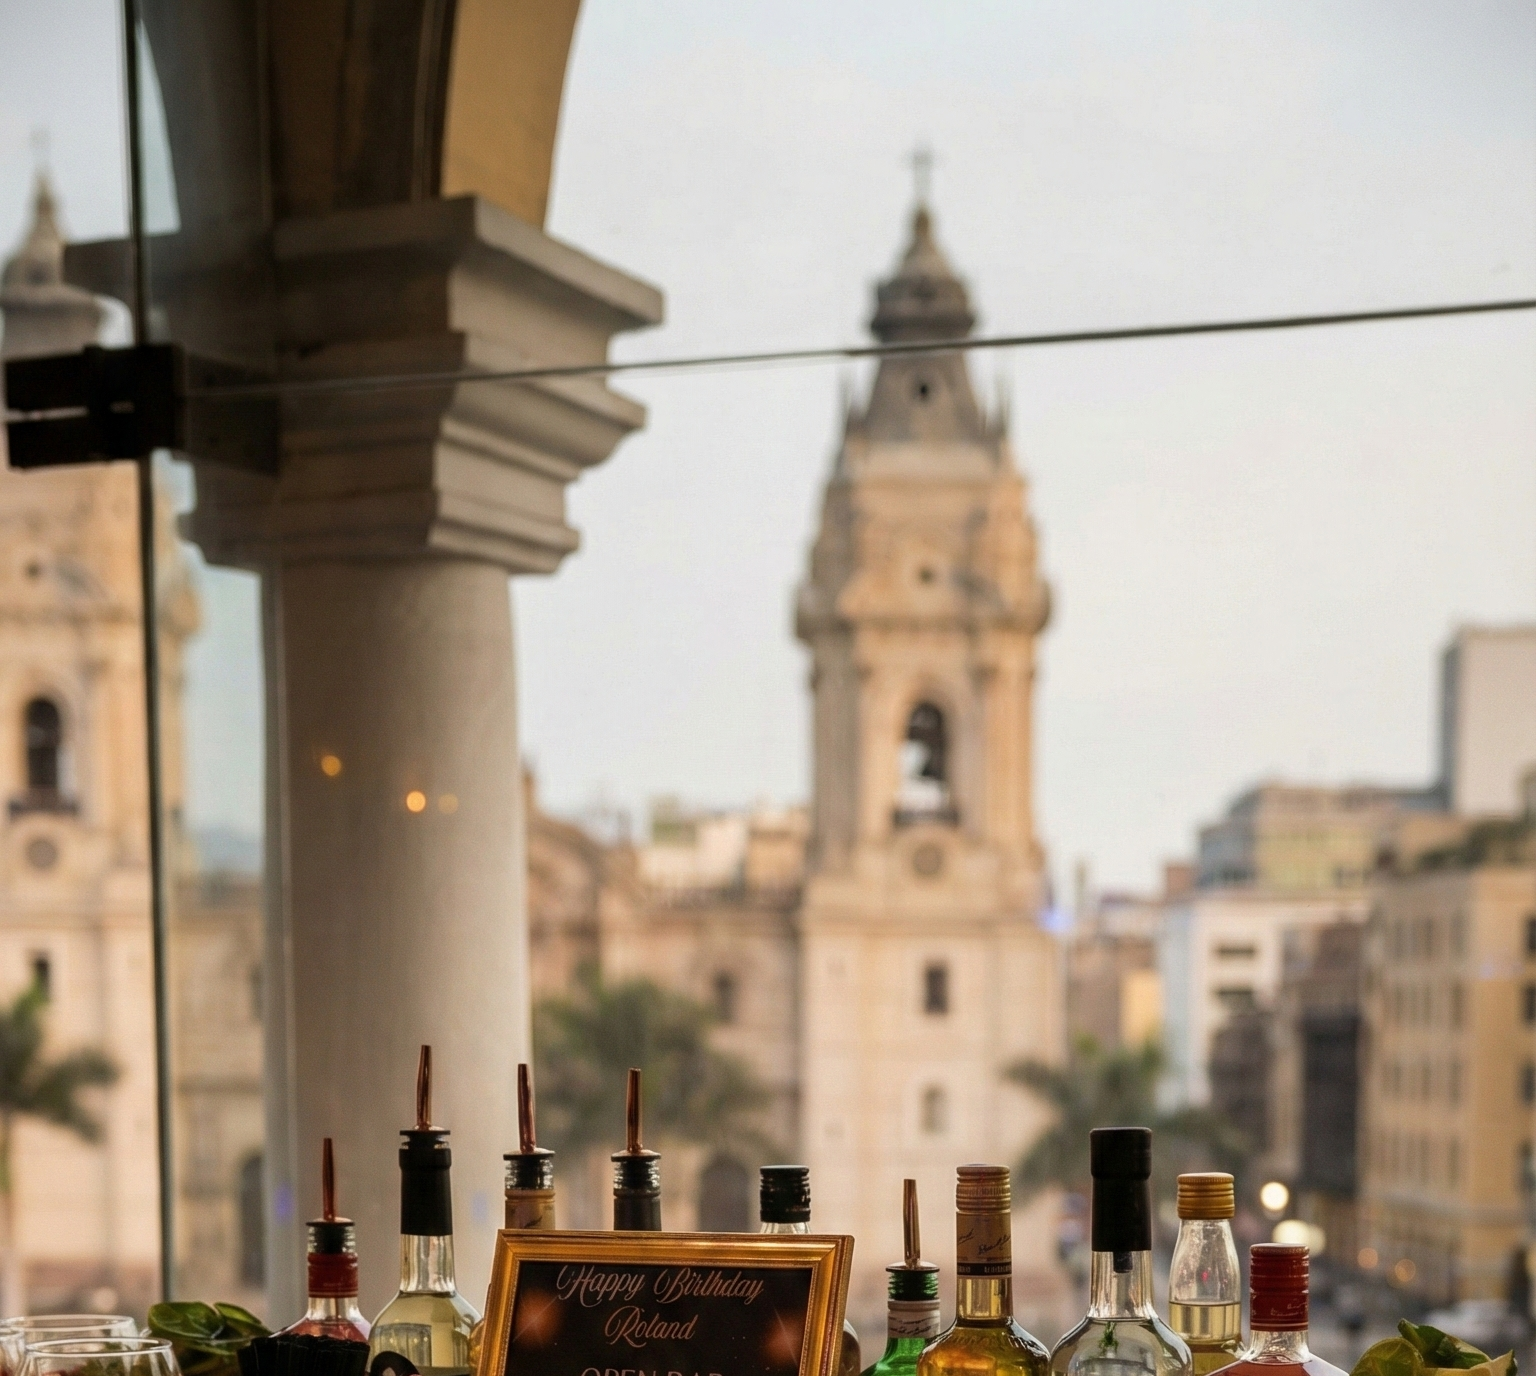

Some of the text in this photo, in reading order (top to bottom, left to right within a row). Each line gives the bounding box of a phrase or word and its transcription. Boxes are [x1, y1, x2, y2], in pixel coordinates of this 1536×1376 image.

[556, 1265, 764, 1307] Happy Birthday
[604, 1305, 698, 1348] Roland
